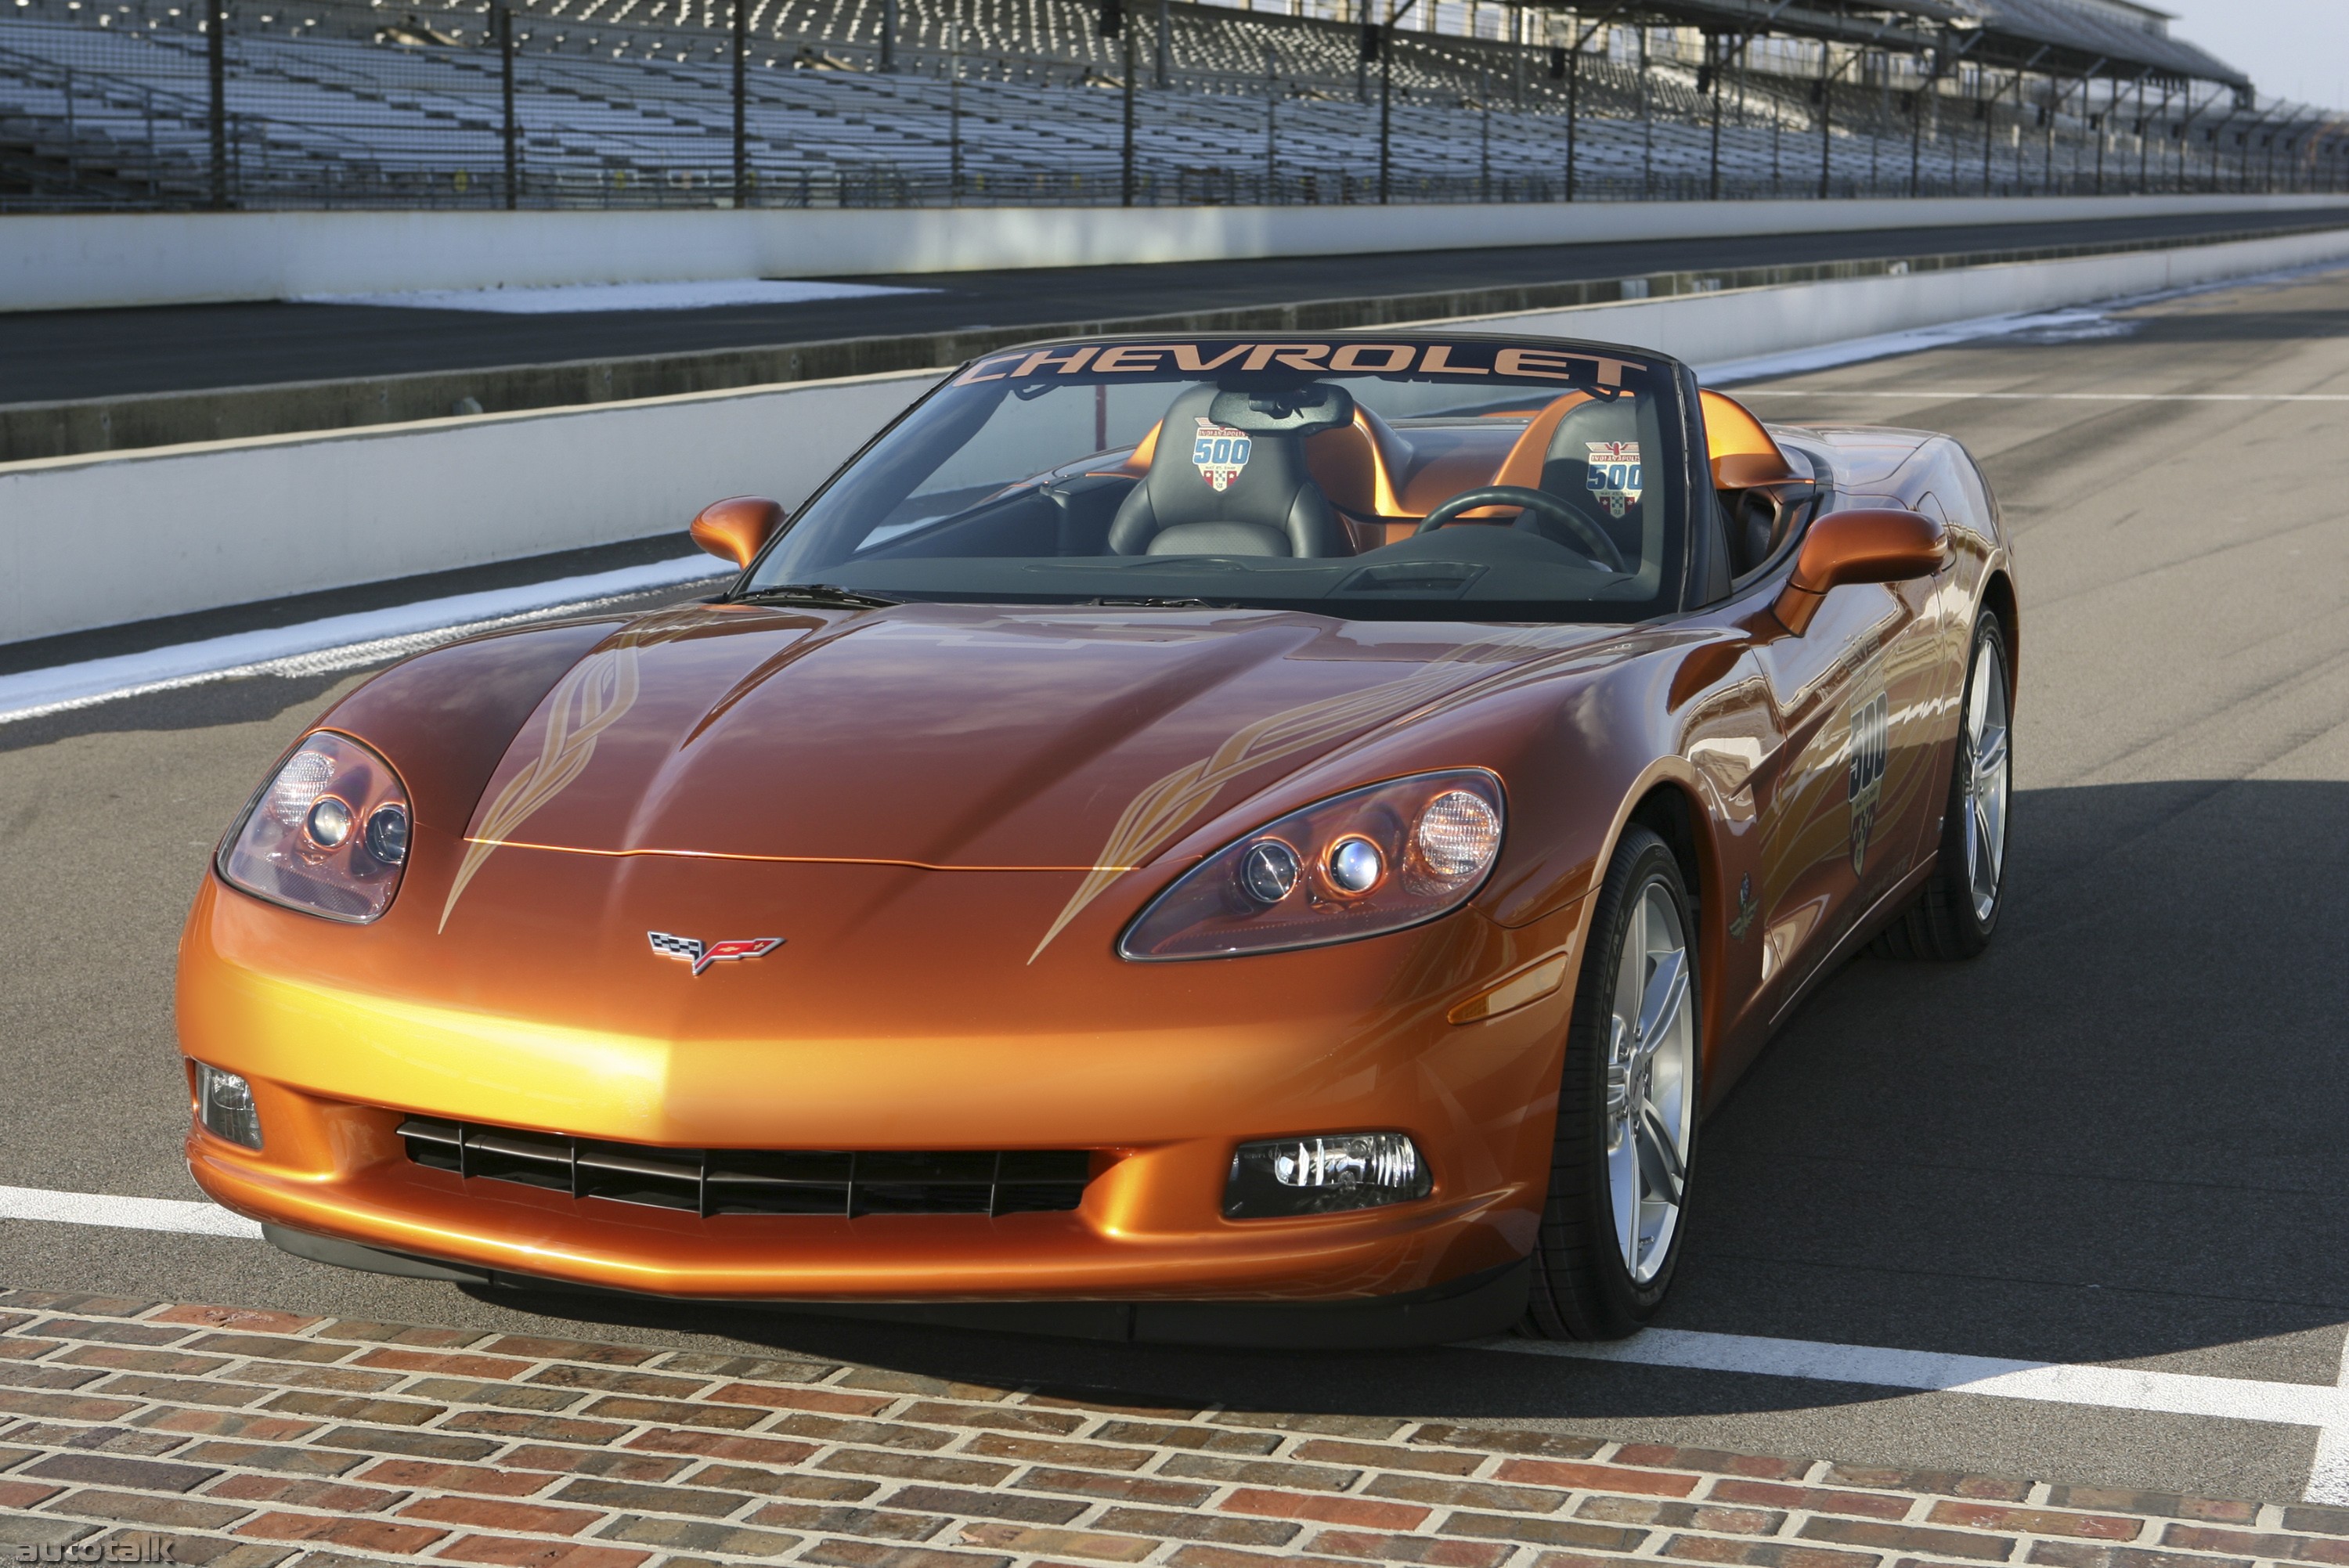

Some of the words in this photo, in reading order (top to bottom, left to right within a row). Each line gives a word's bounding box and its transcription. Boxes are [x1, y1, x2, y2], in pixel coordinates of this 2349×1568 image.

[953, 344, 1647, 387] CHEVROLET
[1193, 438, 1251, 464] 500
[1586, 464, 1643, 490] 500
[1849, 691, 1887, 802] 500
